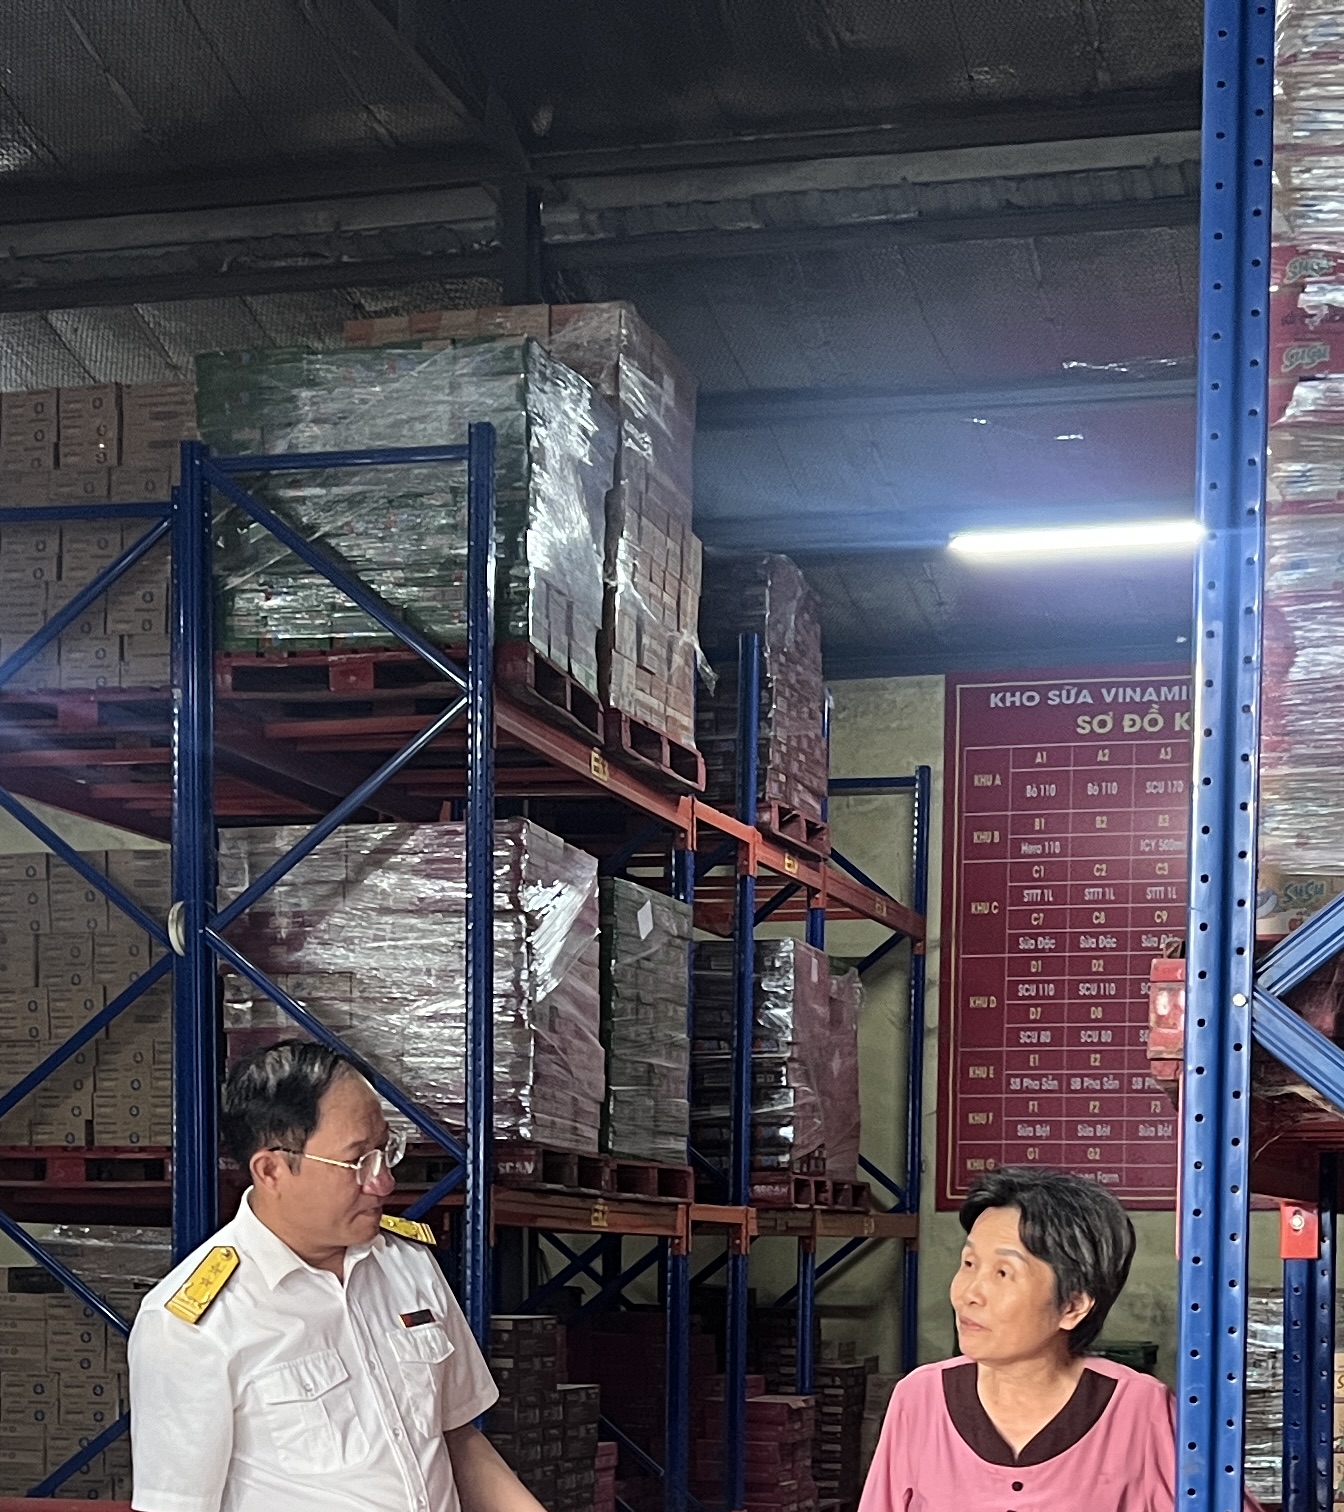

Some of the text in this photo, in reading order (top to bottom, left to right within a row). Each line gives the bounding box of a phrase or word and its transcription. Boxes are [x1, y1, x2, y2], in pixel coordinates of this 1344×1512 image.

[990, 686, 1190, 708] KHO SỮA VINAMI
[1076, 712, 1113, 734] SƠ
[1122, 704, 1163, 732] ĐỒ
[1040, 784, 1056, 796] 110
[1101, 782, 1117, 794] 110
[1039, 984, 1054, 995] 110
[1100, 983, 1116, 995] 110
